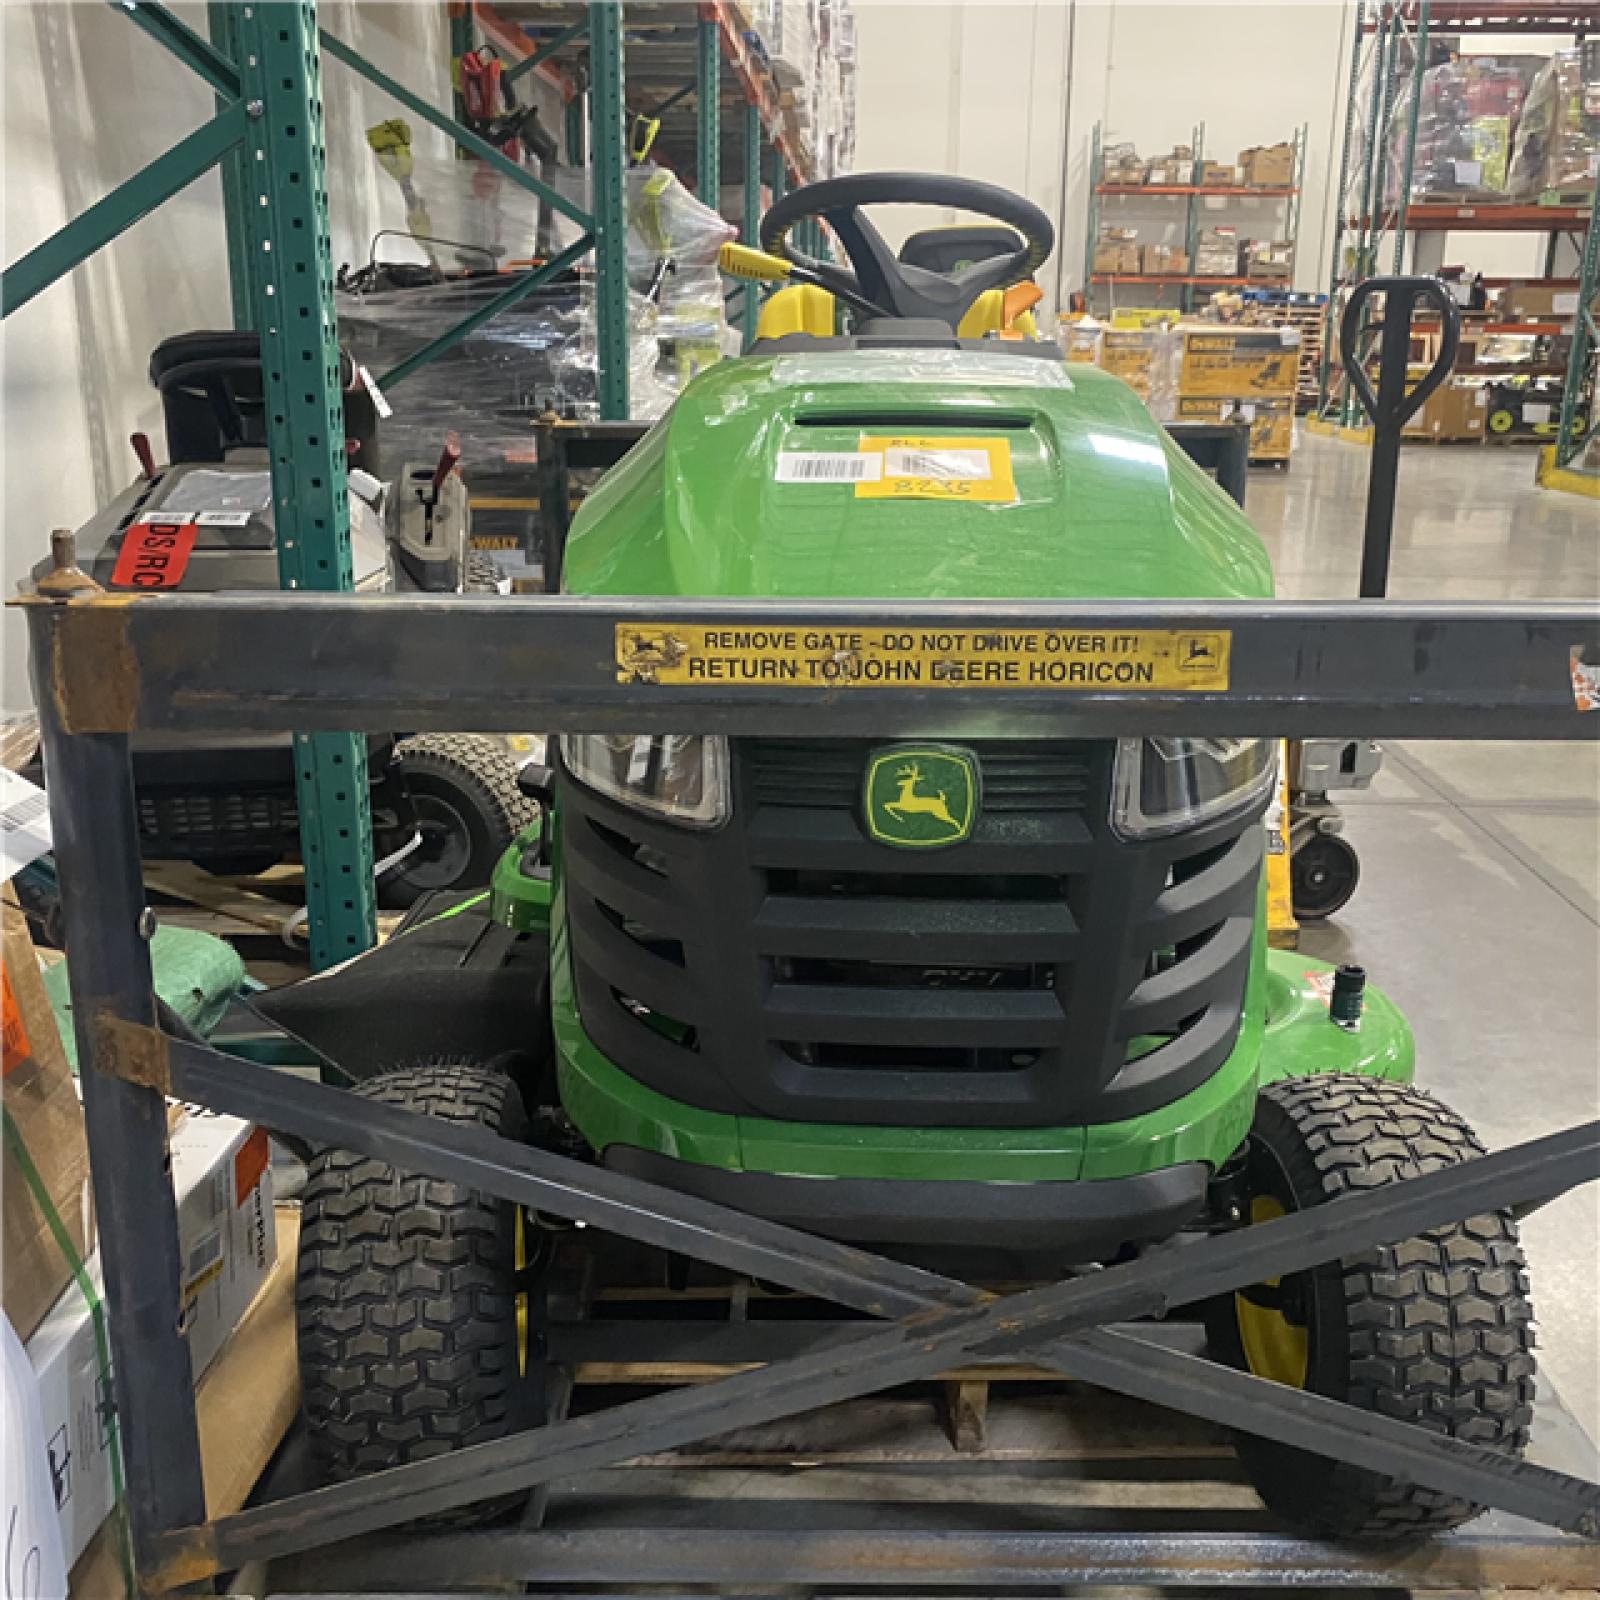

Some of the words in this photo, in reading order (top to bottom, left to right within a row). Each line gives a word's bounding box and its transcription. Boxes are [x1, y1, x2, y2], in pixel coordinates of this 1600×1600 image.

[704, 631, 796, 649] REMOVE
[804, 633, 863, 650] GATE
[921, 634, 966, 652] NOT
[972, 634, 1038, 652] DRIVE
[1044, 634, 1106, 653] OVER
[1111, 635, 1139, 653] IT!
[689, 657, 796, 678] RETURN
[804, 658, 842, 679] TO
[846, 658, 921, 681] JOHN
[930, 659, 1019, 682] DEERE
[1029, 661, 1153, 684] HORICON
